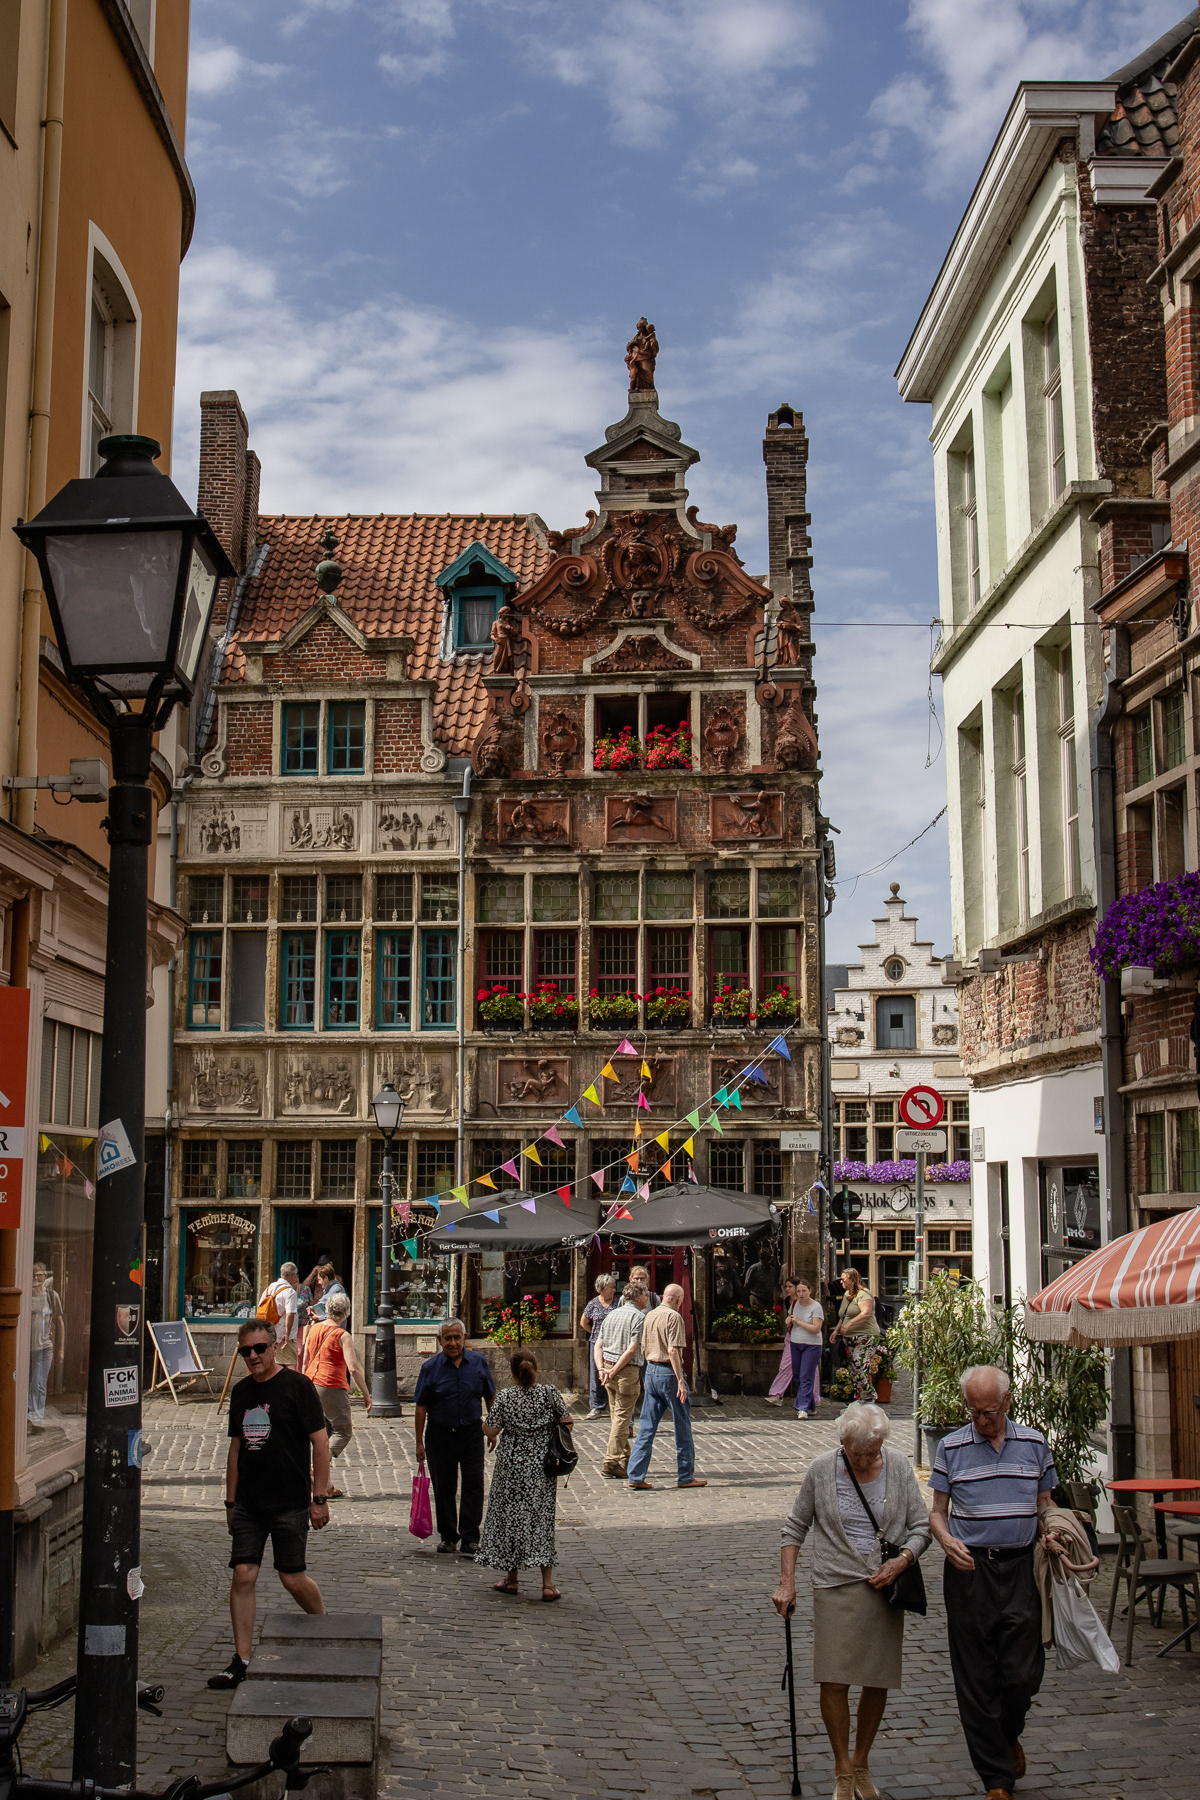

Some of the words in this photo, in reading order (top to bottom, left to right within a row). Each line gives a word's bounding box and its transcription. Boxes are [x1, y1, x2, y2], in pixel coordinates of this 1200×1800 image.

[187, 1214, 256, 1234] TEMMERMAN
[107, 1369, 136, 1384] FCK
[108, 1387, 137, 1397] ANIMAL
[108, 1395, 136, 1403] INDUSTRY
